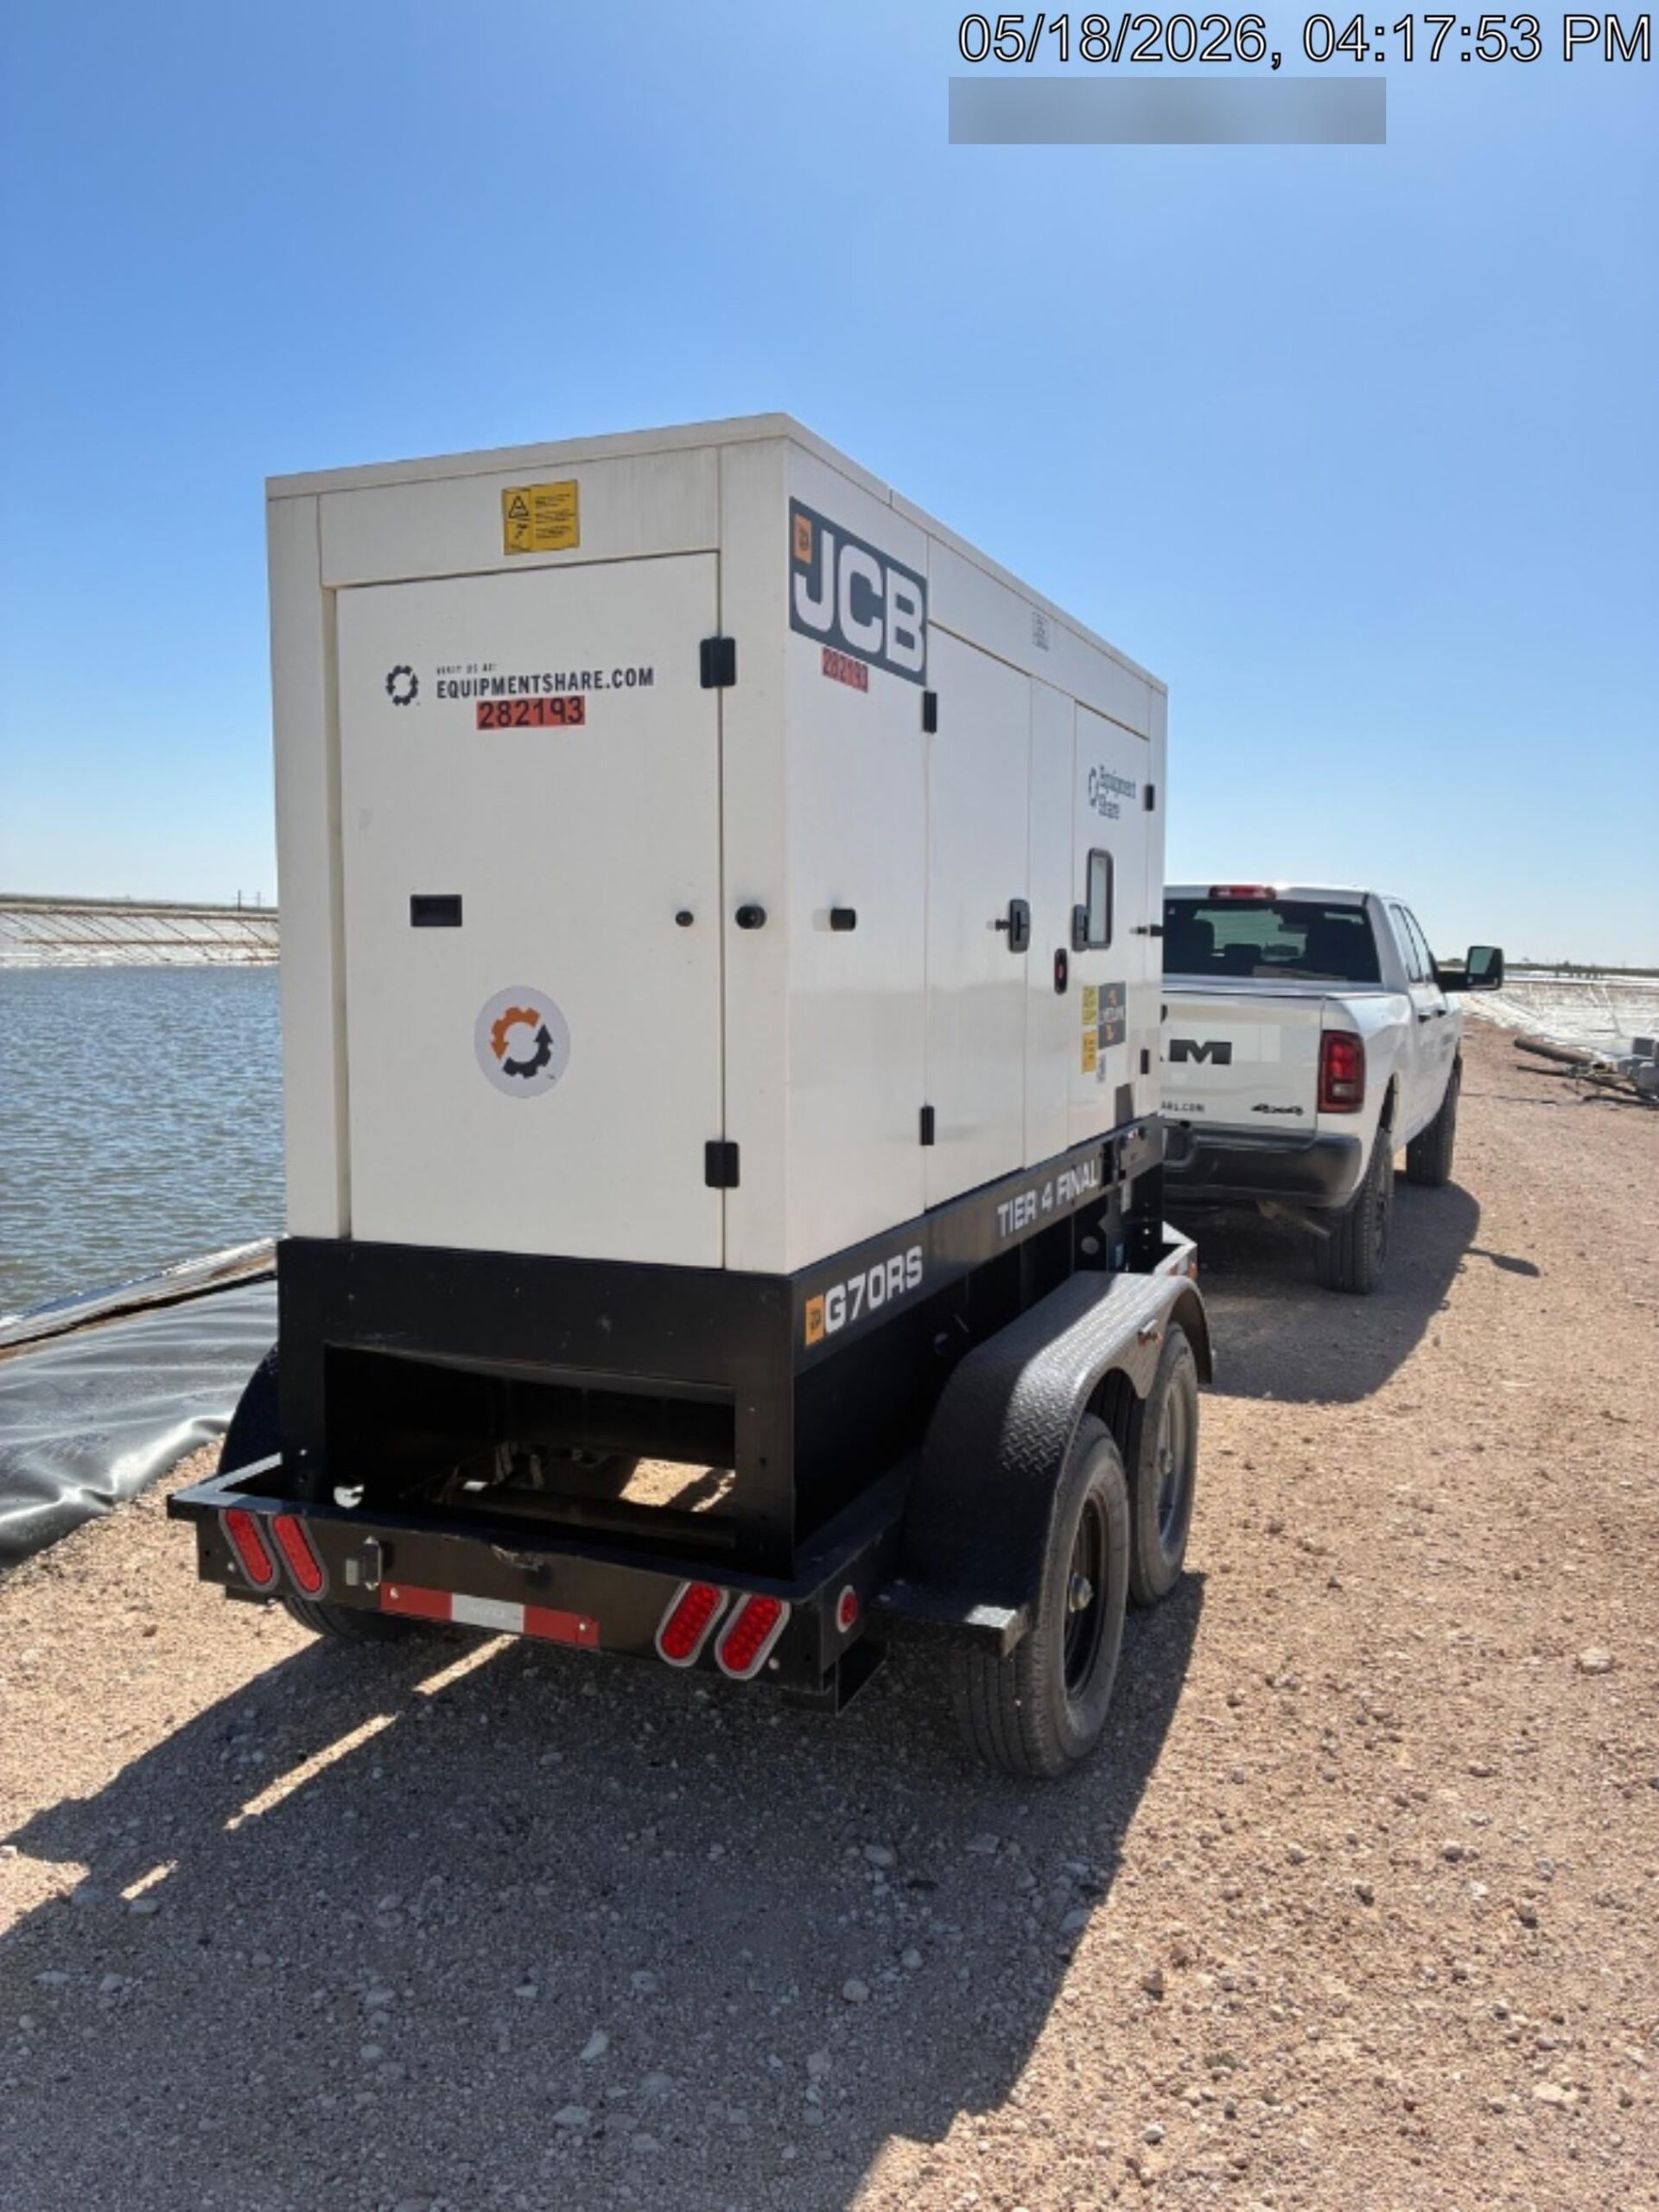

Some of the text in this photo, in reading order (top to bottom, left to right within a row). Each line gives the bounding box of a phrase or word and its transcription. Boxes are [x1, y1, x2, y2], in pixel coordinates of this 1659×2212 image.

[793, 529, 925, 672] JCB
[436, 666, 654, 699] EQUIPMENTSHARE.COM
[478, 696, 585, 729] 282193
[1160, 1039, 1232, 1065] M
[997, 1159, 1099, 1237] TIER 4 FINAL
[823, 1244, 924, 1334] G70RS
